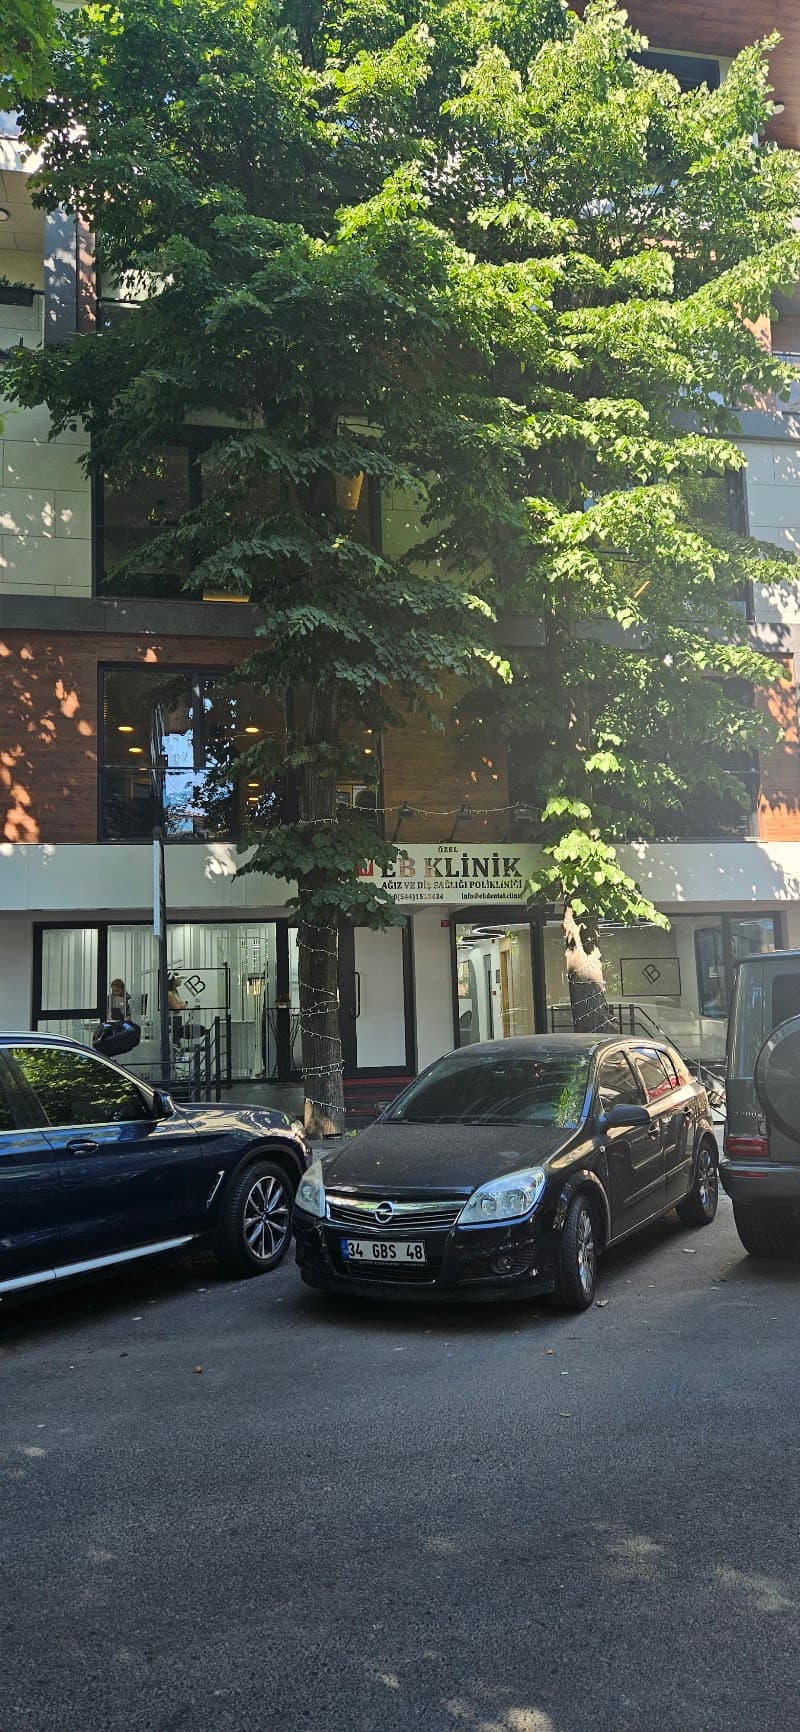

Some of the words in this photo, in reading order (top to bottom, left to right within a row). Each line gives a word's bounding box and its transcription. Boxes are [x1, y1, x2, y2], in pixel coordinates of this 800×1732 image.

[381, 858, 416, 877] EB
[424, 853, 522, 877] KLİNİK
[382, 880, 402, 889] AĞIZ
[403, 881, 416, 889] VE
[417, 880, 431, 890] DİŞ
[348, 1242, 363, 1258] 34
[372, 1243, 397, 1259] GBS
[406, 1244, 423, 1259] 48
